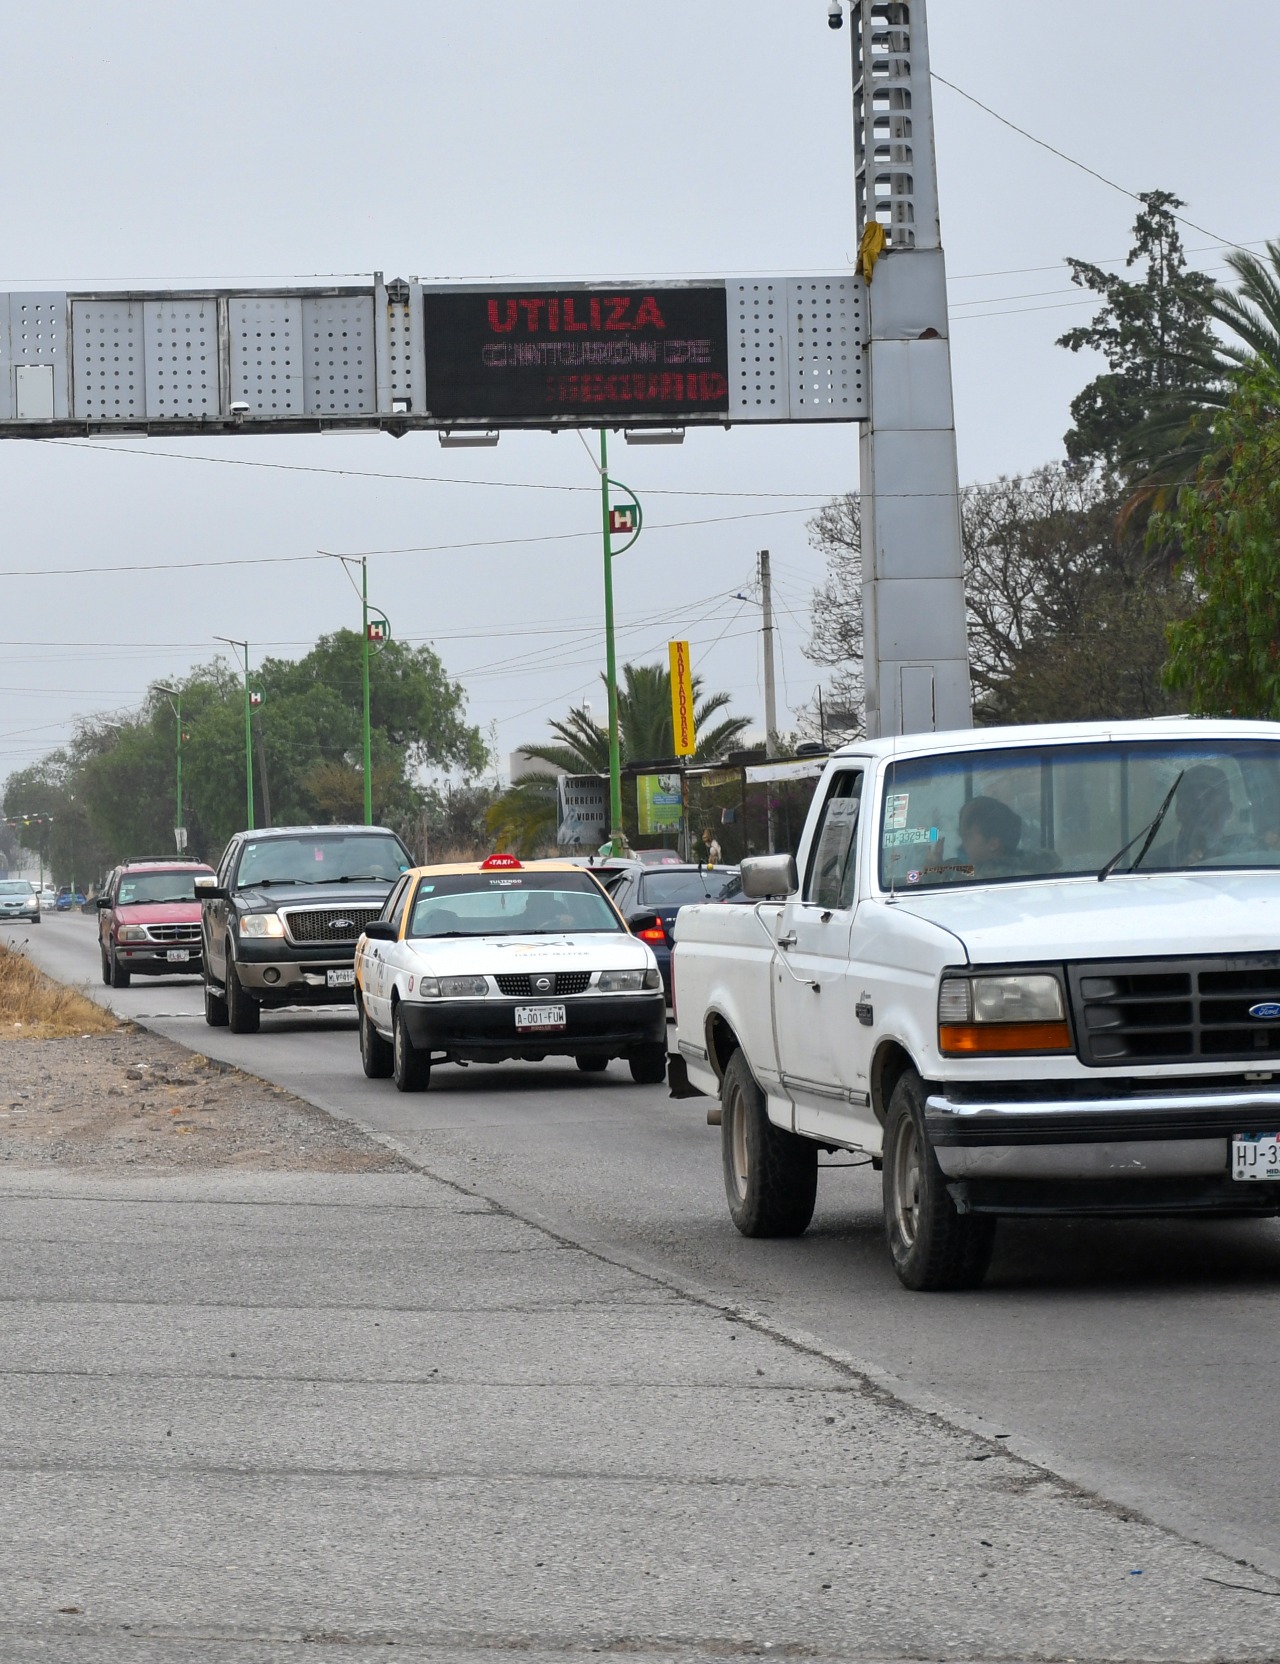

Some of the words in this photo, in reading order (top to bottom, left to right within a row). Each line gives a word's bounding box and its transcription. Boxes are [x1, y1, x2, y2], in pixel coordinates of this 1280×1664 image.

[487, 297, 667, 333] UTILIZA
[664, 339, 712, 365] DE
[676, 642, 689, 748] RADIADORES
[576, 812, 604, 821] VIDRIO
[517, 1011, 565, 1025] A-001-FUW
[1258, 1006, 1280, 1016] Ford
[1237, 1144, 1280, 1167] HJ-3
